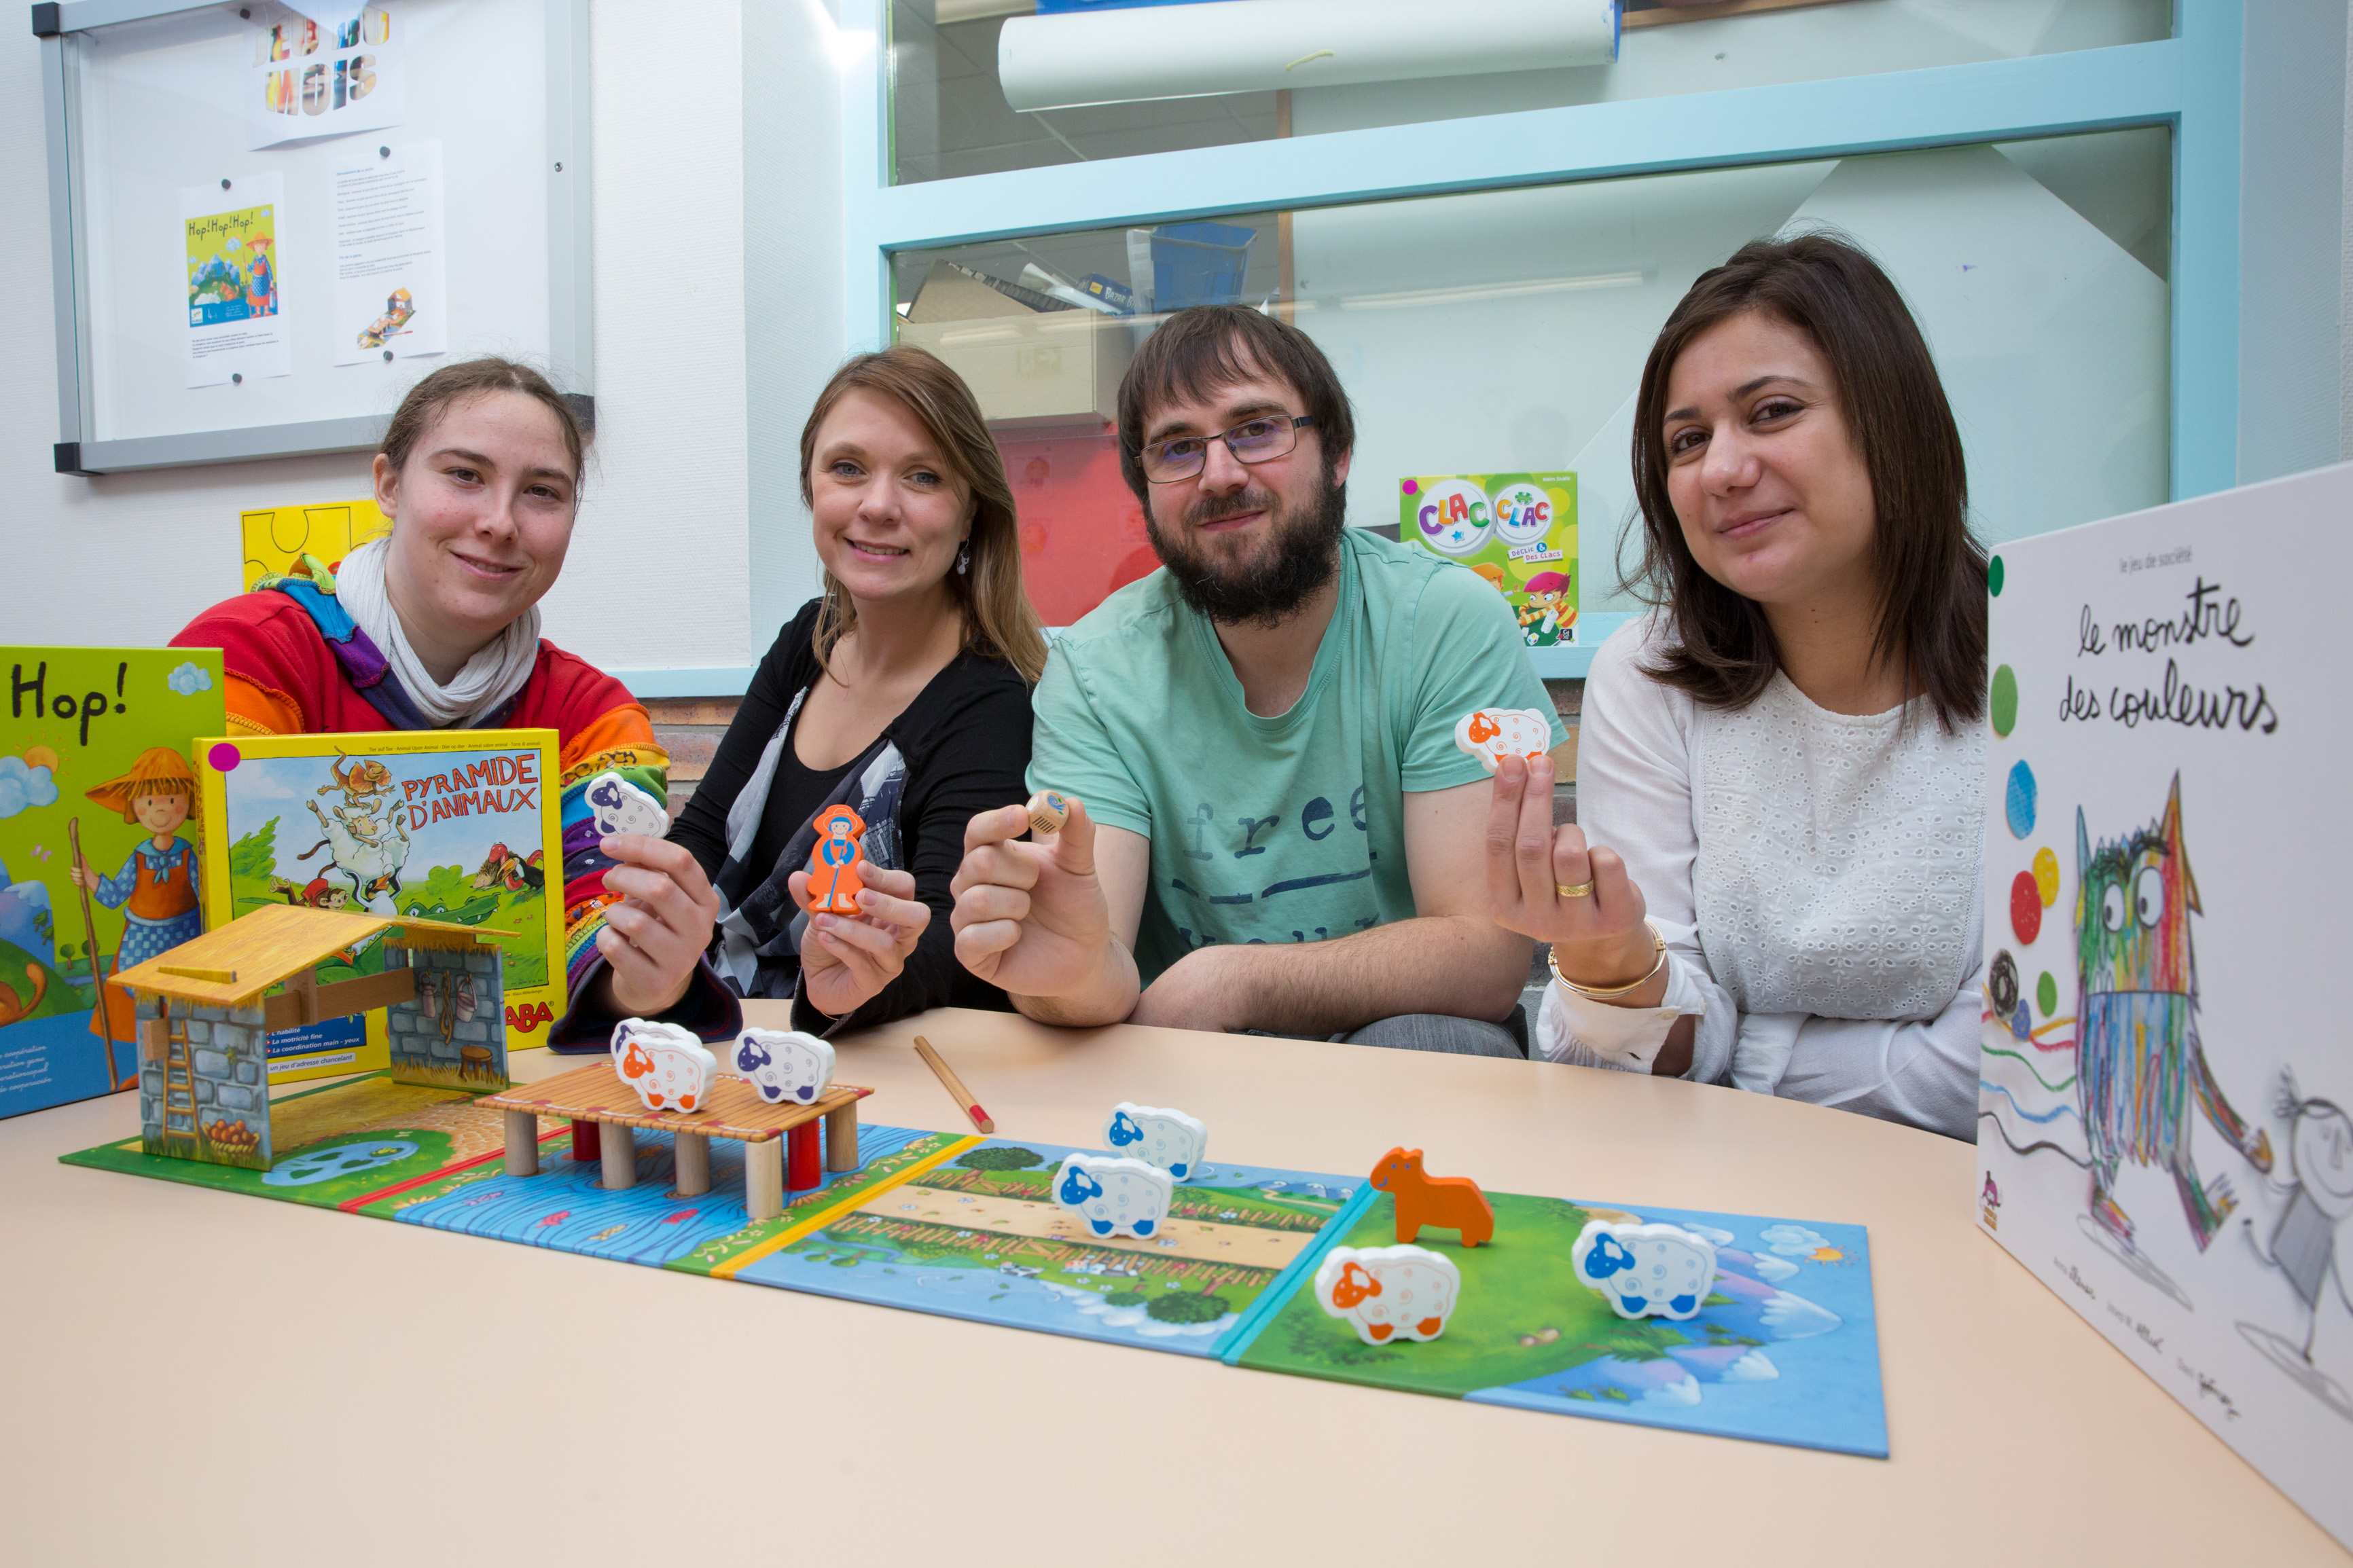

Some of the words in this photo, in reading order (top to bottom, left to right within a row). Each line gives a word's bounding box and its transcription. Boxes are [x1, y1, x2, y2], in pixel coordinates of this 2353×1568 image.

[266, 54, 376, 116] MOIS
[1419, 493, 1490, 535] CLAC
[1496, 499, 1550, 528] CLAC
[2078, 604, 2106, 657] le
[2113, 576, 2255, 653] monstre
[12, 661, 128, 746] Hop!
[2060, 674, 2100, 722] des
[2110, 657, 2278, 734] couleurs
[401, 754, 539, 801] PYRAMIDE
[407, 787, 537, 831] D'ANIMAUX
[272, 1027, 301, 1036] Lhabilité
[281, 1034, 309, 1044] motricité
[505, 1002, 554, 1034] ABA
[26, 1057, 46, 1068] game
[279, 1063, 289, 1072] jeu
[291, 1060, 319, 1068] d'adresse
[321, 1055, 353, 1064] chancelant
[281, 1042, 322, 1052] coordination
[344, 1037, 360, 1045] yeux
